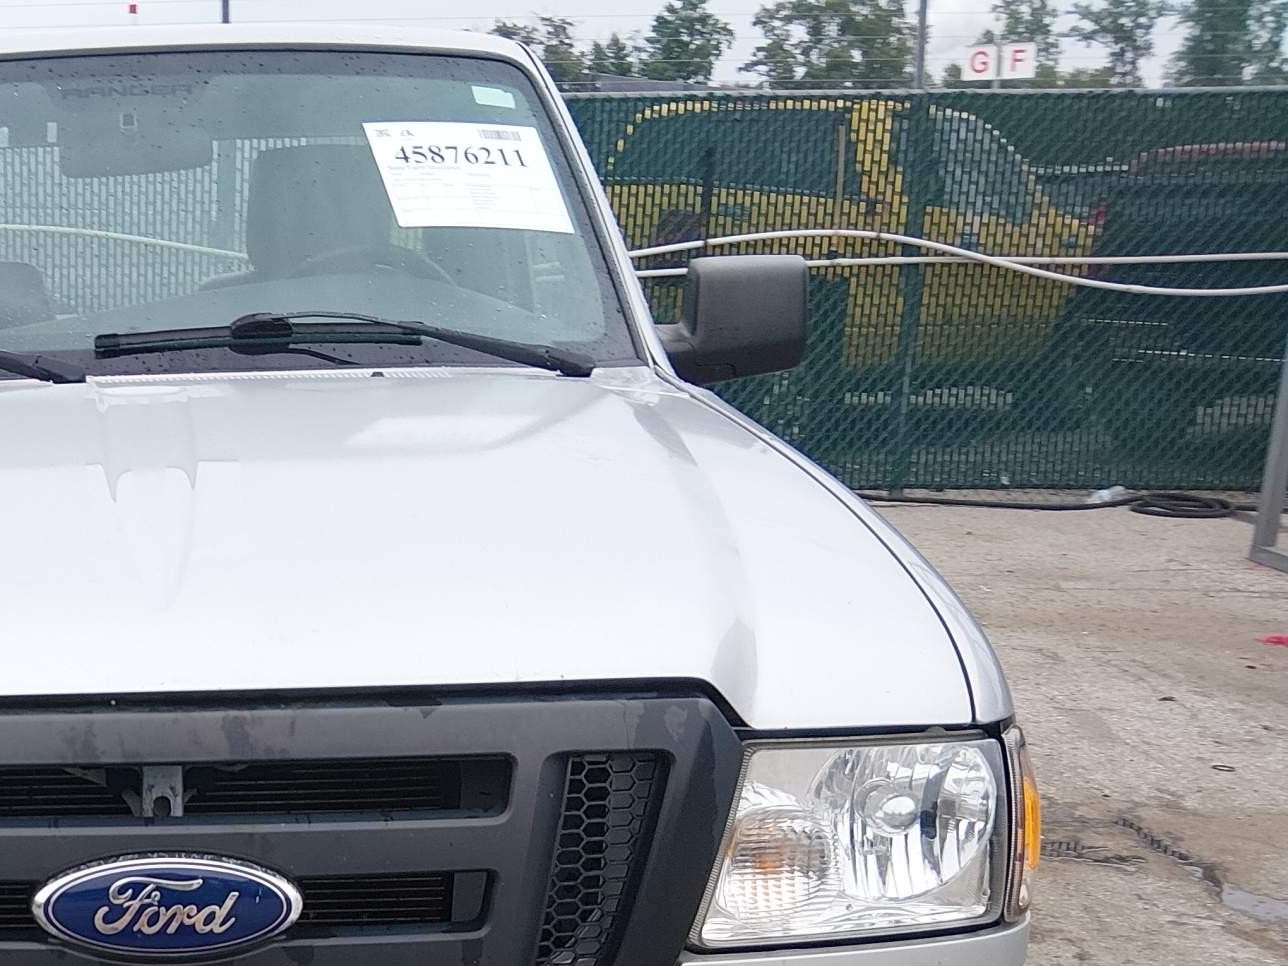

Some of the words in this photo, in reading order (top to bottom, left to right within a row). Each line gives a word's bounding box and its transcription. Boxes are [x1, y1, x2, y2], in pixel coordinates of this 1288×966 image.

[971, 51, 989, 74] G
[1010, 49, 1027, 73] F
[395, 145, 528, 168] 45876211
[94, 876, 239, 935] Ford
